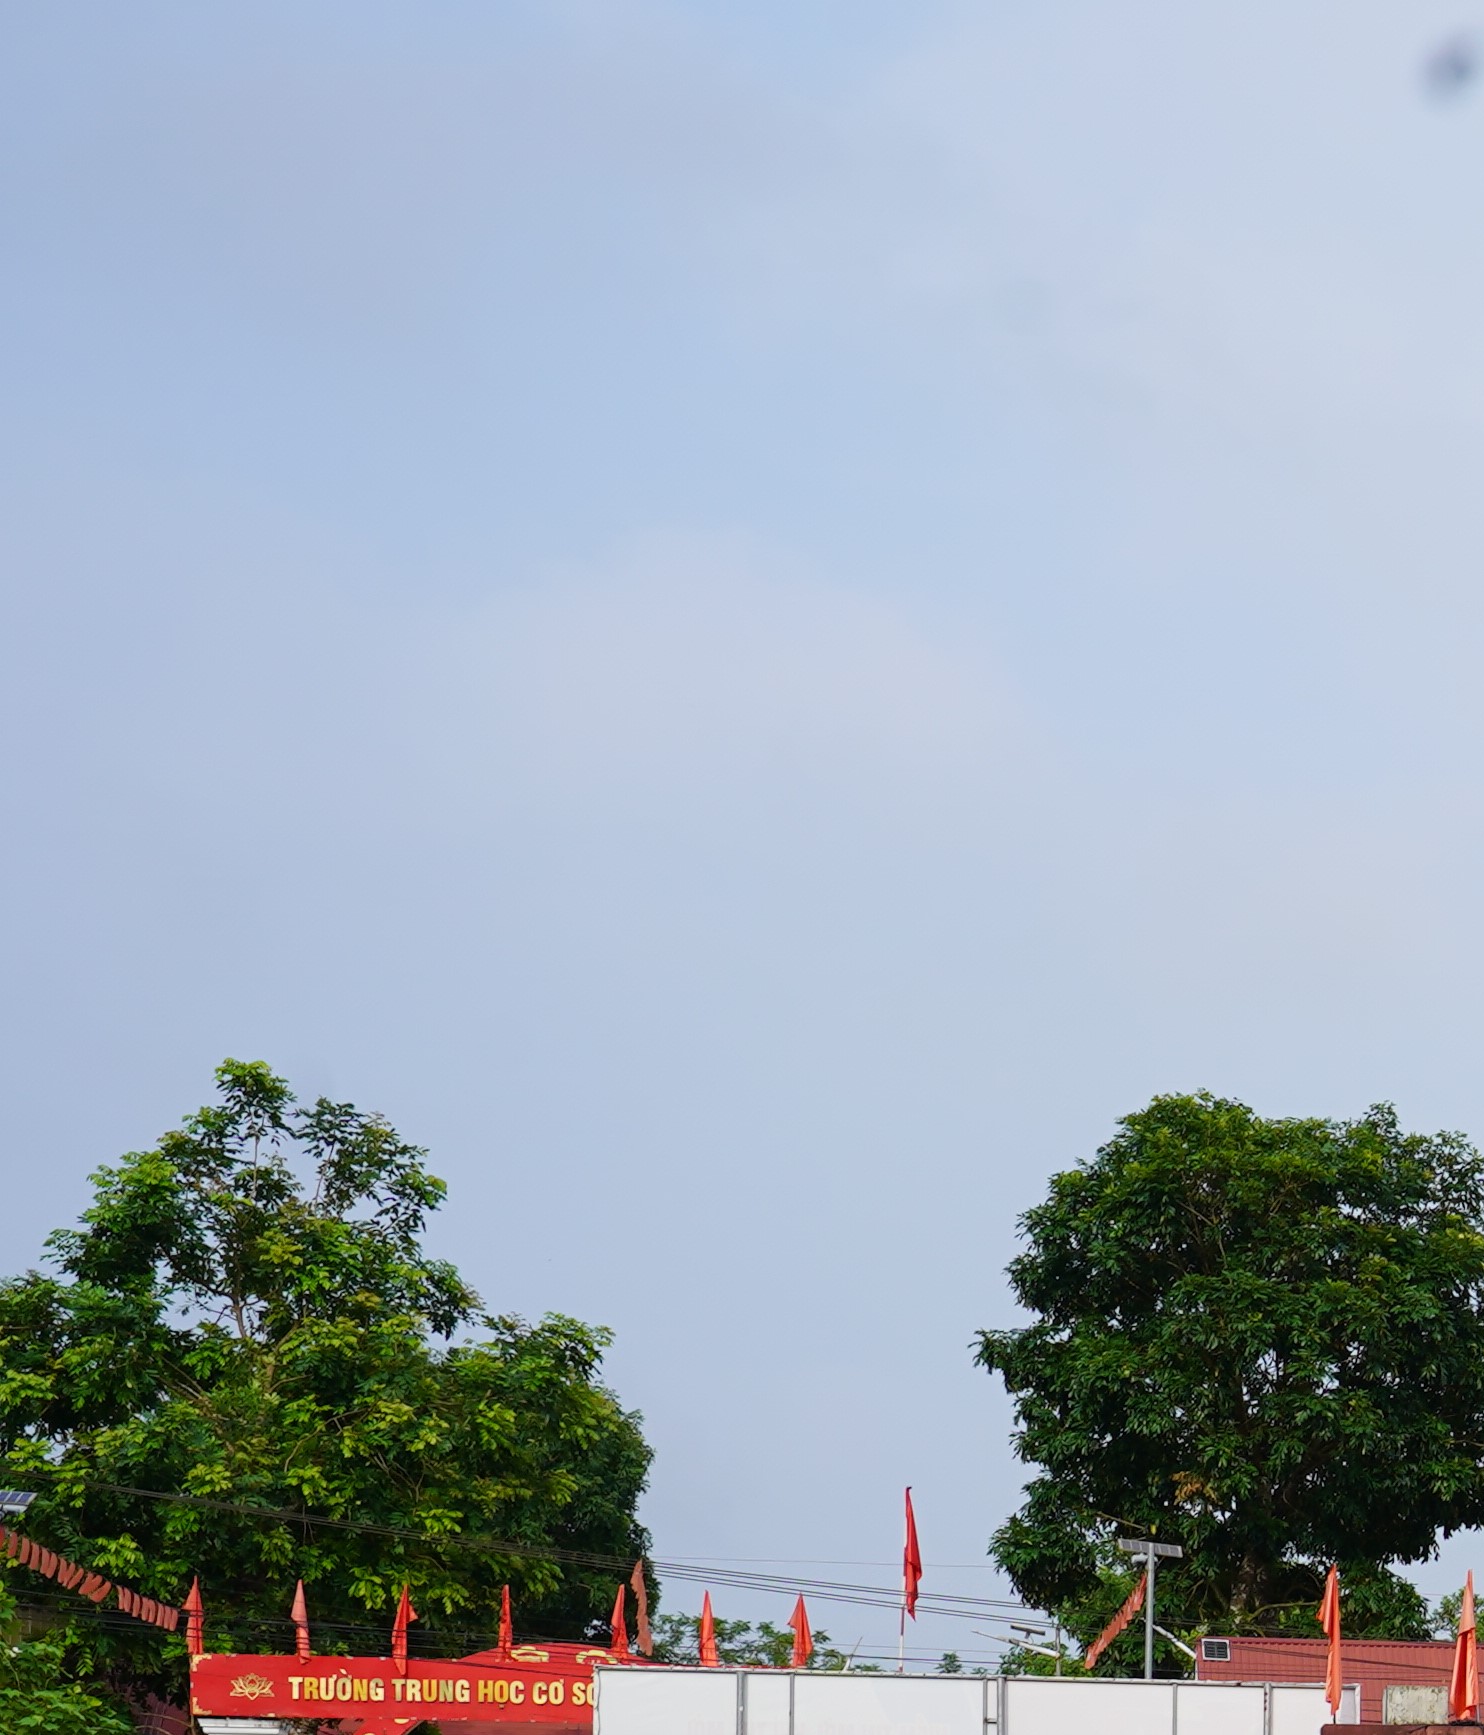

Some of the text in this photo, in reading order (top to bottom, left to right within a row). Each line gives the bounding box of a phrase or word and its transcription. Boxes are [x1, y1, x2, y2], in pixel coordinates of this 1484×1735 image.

[288, 1669, 385, 1702] TRƯỜNG
[392, 1678, 471, 1703] TRUNG
[477, 1680, 525, 1708] HỌC
[532, 1678, 566, 1705] CƠ
